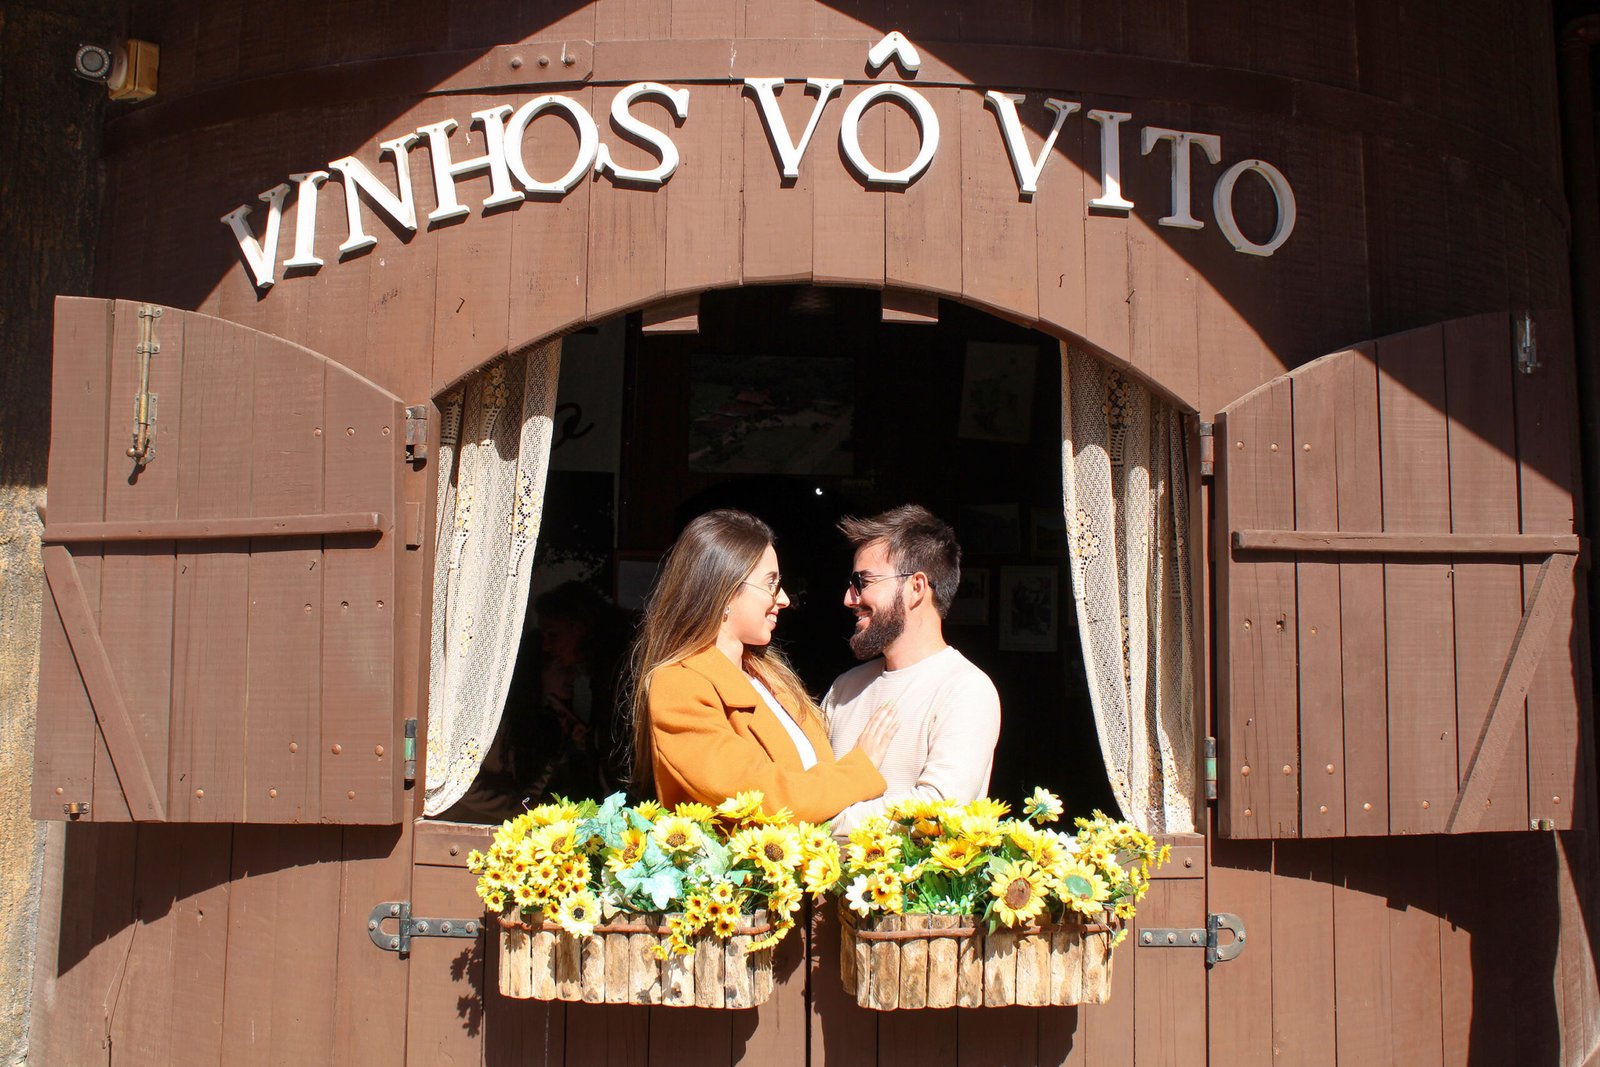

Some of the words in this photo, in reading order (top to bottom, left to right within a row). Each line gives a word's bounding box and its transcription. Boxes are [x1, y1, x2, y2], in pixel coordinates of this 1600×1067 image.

[220, 82, 690, 288] VINHOS
[743, 30, 940, 184] VÔ
[984, 90, 1297, 257] VITO
